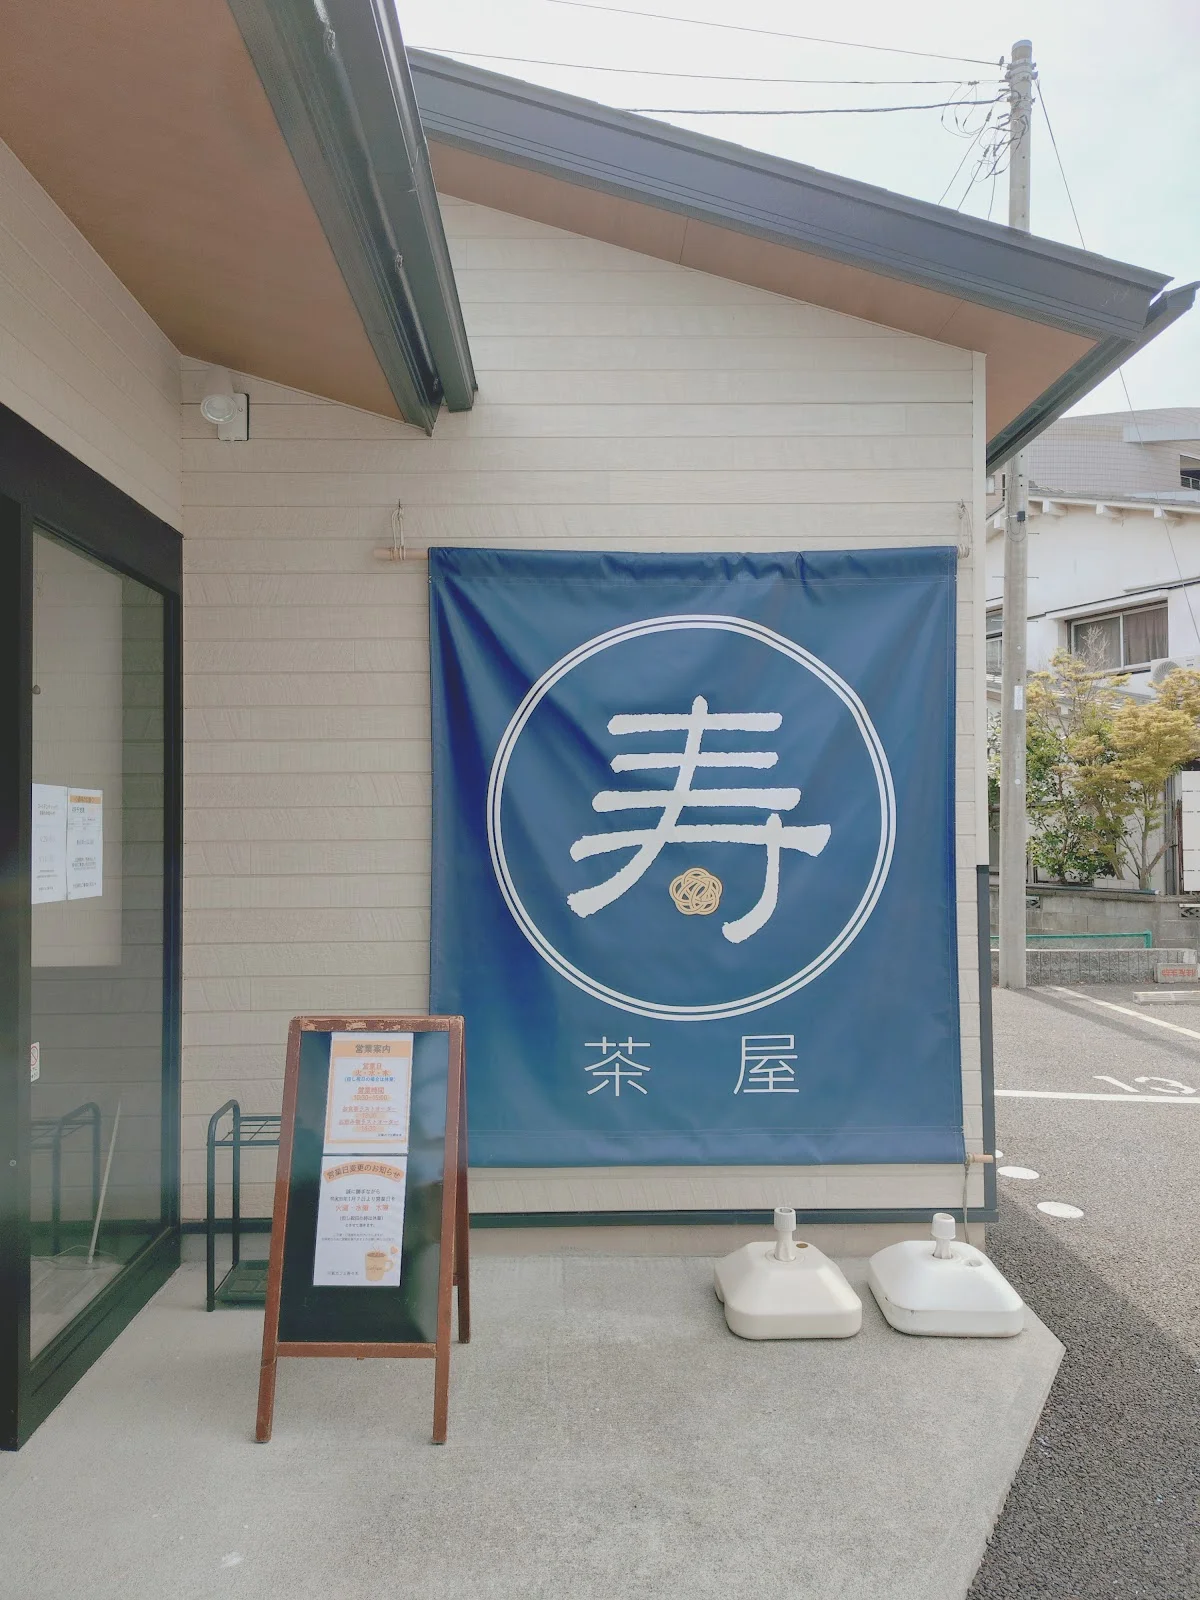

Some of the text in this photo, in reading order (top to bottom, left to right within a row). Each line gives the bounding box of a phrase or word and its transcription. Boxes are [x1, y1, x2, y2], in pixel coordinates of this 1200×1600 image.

[567, 695, 832, 944] 寿
[355, 1044, 391, 1054] 営業案内
[1093, 1075, 1197, 1095] 13
[327, 1163, 401, 1179] 営業日変更のお知らせ
